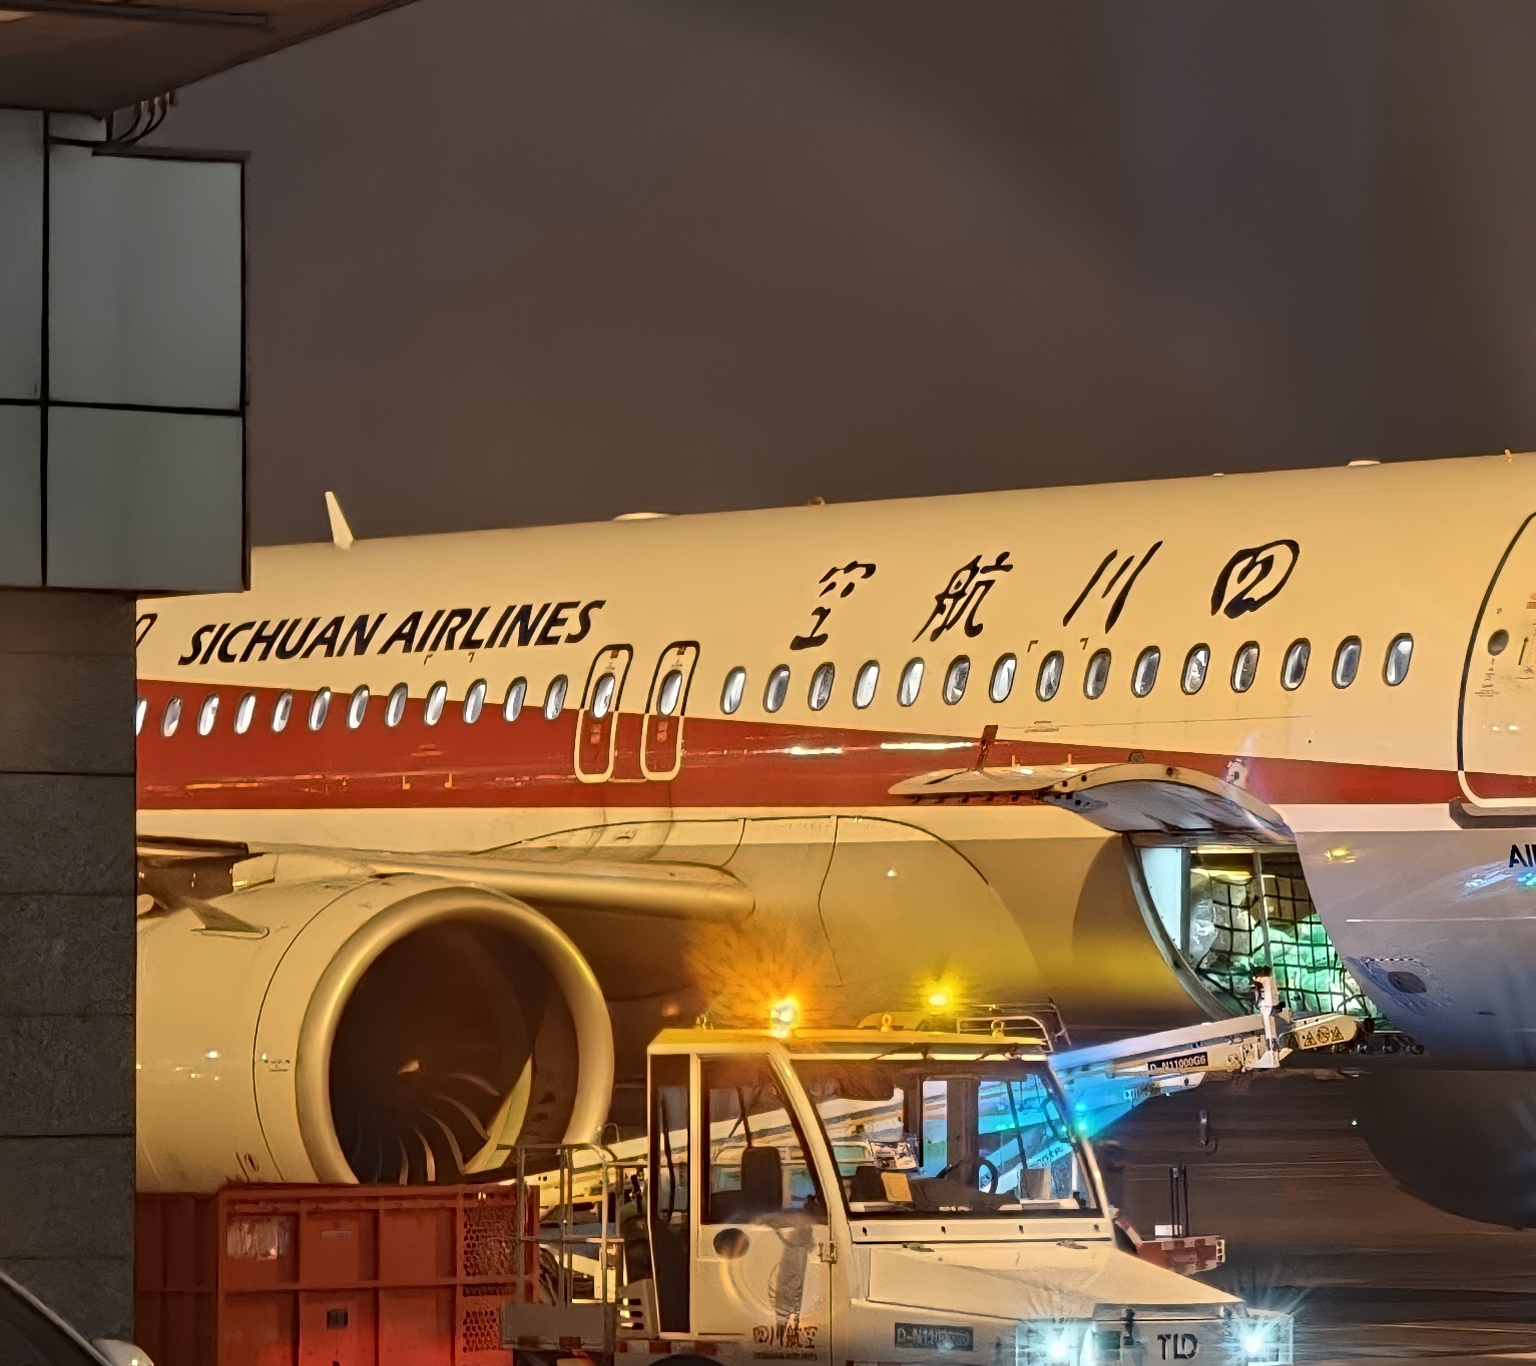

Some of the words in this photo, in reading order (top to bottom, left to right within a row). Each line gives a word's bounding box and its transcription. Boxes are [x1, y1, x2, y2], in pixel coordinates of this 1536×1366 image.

[177, 613, 388, 666] SICHUAN
[378, 599, 606, 655] AIRLINES
[1156, 1332, 1199, 1361] TLD
